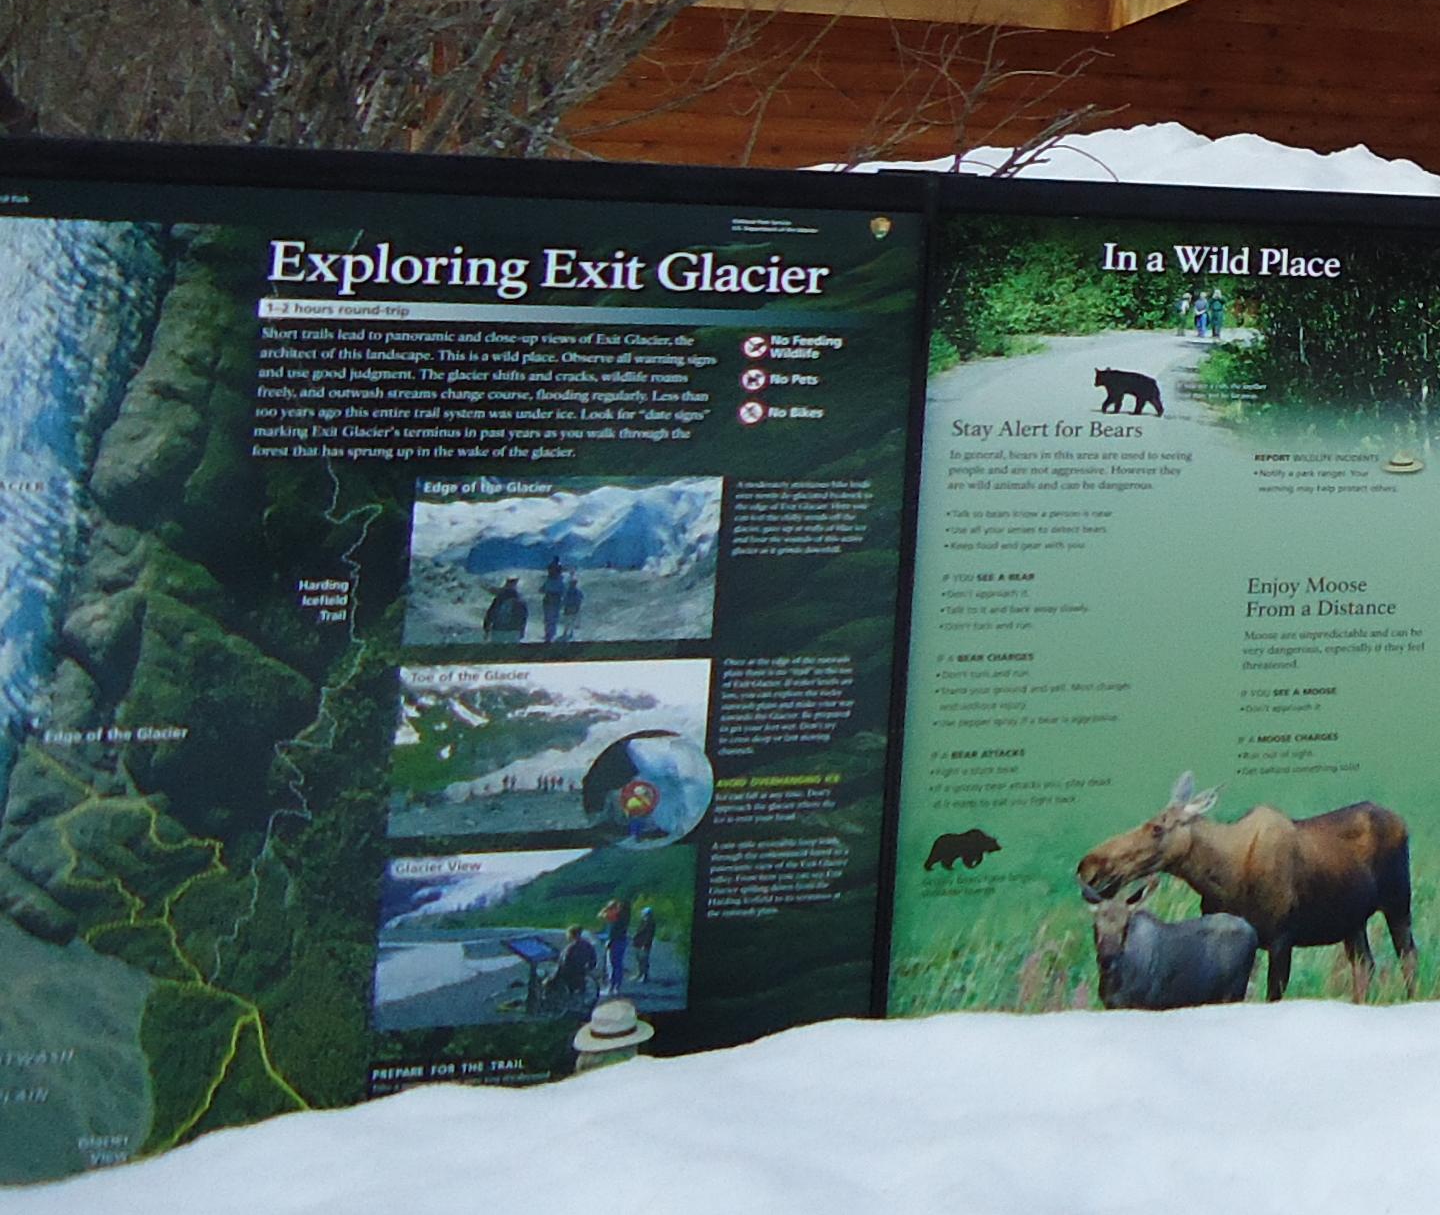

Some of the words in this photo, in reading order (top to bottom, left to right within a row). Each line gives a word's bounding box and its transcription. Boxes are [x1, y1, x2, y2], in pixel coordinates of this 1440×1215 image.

[1102, 242, 1139, 270] In
[1145, 252, 1166, 271] a
[1173, 245, 1250, 274] Wild
[1259, 249, 1342, 277] Place
[269, 241, 529, 298] Exploring
[541, 249, 645, 289] Exit
[657, 252, 829, 293] Glacier
[262, 327, 298, 339] Short
[301, 328, 335, 339] trails
[337, 328, 366, 340] lead
[368, 331, 383, 340] to
[385, 331, 455, 343] panoramic
[457, 331, 482, 342] and
[484, 331, 539, 346] close-up
[541, 334, 577, 343] views
[578, 333, 595, 344] of
[595, 333, 621, 344] Exit
[623, 334, 674, 345] Glacier,
[674, 335, 695, 346] the
[770, 336, 790, 346] No
[792, 336, 843, 349] Feeding
[260, 346, 317, 359] architect
[320, 347, 337, 359] of
[338, 347, 363, 359] this
[365, 348, 434, 363] landscape.
[438, 349, 466, 361] This
[468, 350, 480, 361] is
[481, 353, 490, 361] a
[491, 350, 520, 362] wild
[521, 351, 559, 364] place.
[561, 351, 615, 363] Observe
[616, 352, 633, 363] all
[634, 354, 686, 366] warning
[687, 354, 718, 367] signs
[770, 348, 820, 359] Wildlife
[769, 373, 790, 384] No
[791, 374, 819, 385] Pets
[768, 407, 788, 417] No
[789, 407, 824, 418] Bikes
[951, 419, 993, 441] Stay
[998, 420, 1049, 437] Alert
[1055, 420, 1084, 437] for
[1089, 421, 1143, 437] Bears
[949, 449, 963, 459] In
[963, 450, 1007, 461] general,
[1008, 450, 1039, 459] bears
[1040, 452, 1052, 460] in
[1053, 450, 1075, 459] this
[1076, 452, 1100, 460] area
[1101, 452, 1119, 460] are
[1120, 450, 1146, 460] used
[1147, 451, 1160, 460] to
[1160, 452, 1193, 462] seeing
[423, 482, 459, 495] Edge
[461, 481, 477, 493] of
[480, 482, 503, 493] the
[506, 481, 553, 494] Glacier
[298, 579, 350, 592] Harding
[1247, 577, 1300, 598] Enjoy
[1306, 577, 1367, 593] Moose
[302, 594, 349, 606] Icefield
[1246, 601, 1295, 617] From
[1301, 604, 1311, 616] a
[1318, 600, 1396, 616] Distance
[320, 610, 347, 621] Trail
[411, 671, 434, 682] Toe
[439, 669, 453, 682] of
[458, 670, 480, 681] the
[484, 669, 530, 681] Glacier
[44, 730, 82, 743] Edge
[86, 727, 103, 741] of
[107, 727, 132, 740] the
[136, 727, 188, 739] Glacier
[394, 861, 442, 873] Glacier
[445, 860, 482, 872] View
[372, 1066, 424, 1079] PREPARE
[431, 1063, 456, 1075] FOR
[461, 1061, 484, 1073] THE
[491, 1059, 524, 1071] TRAIL
